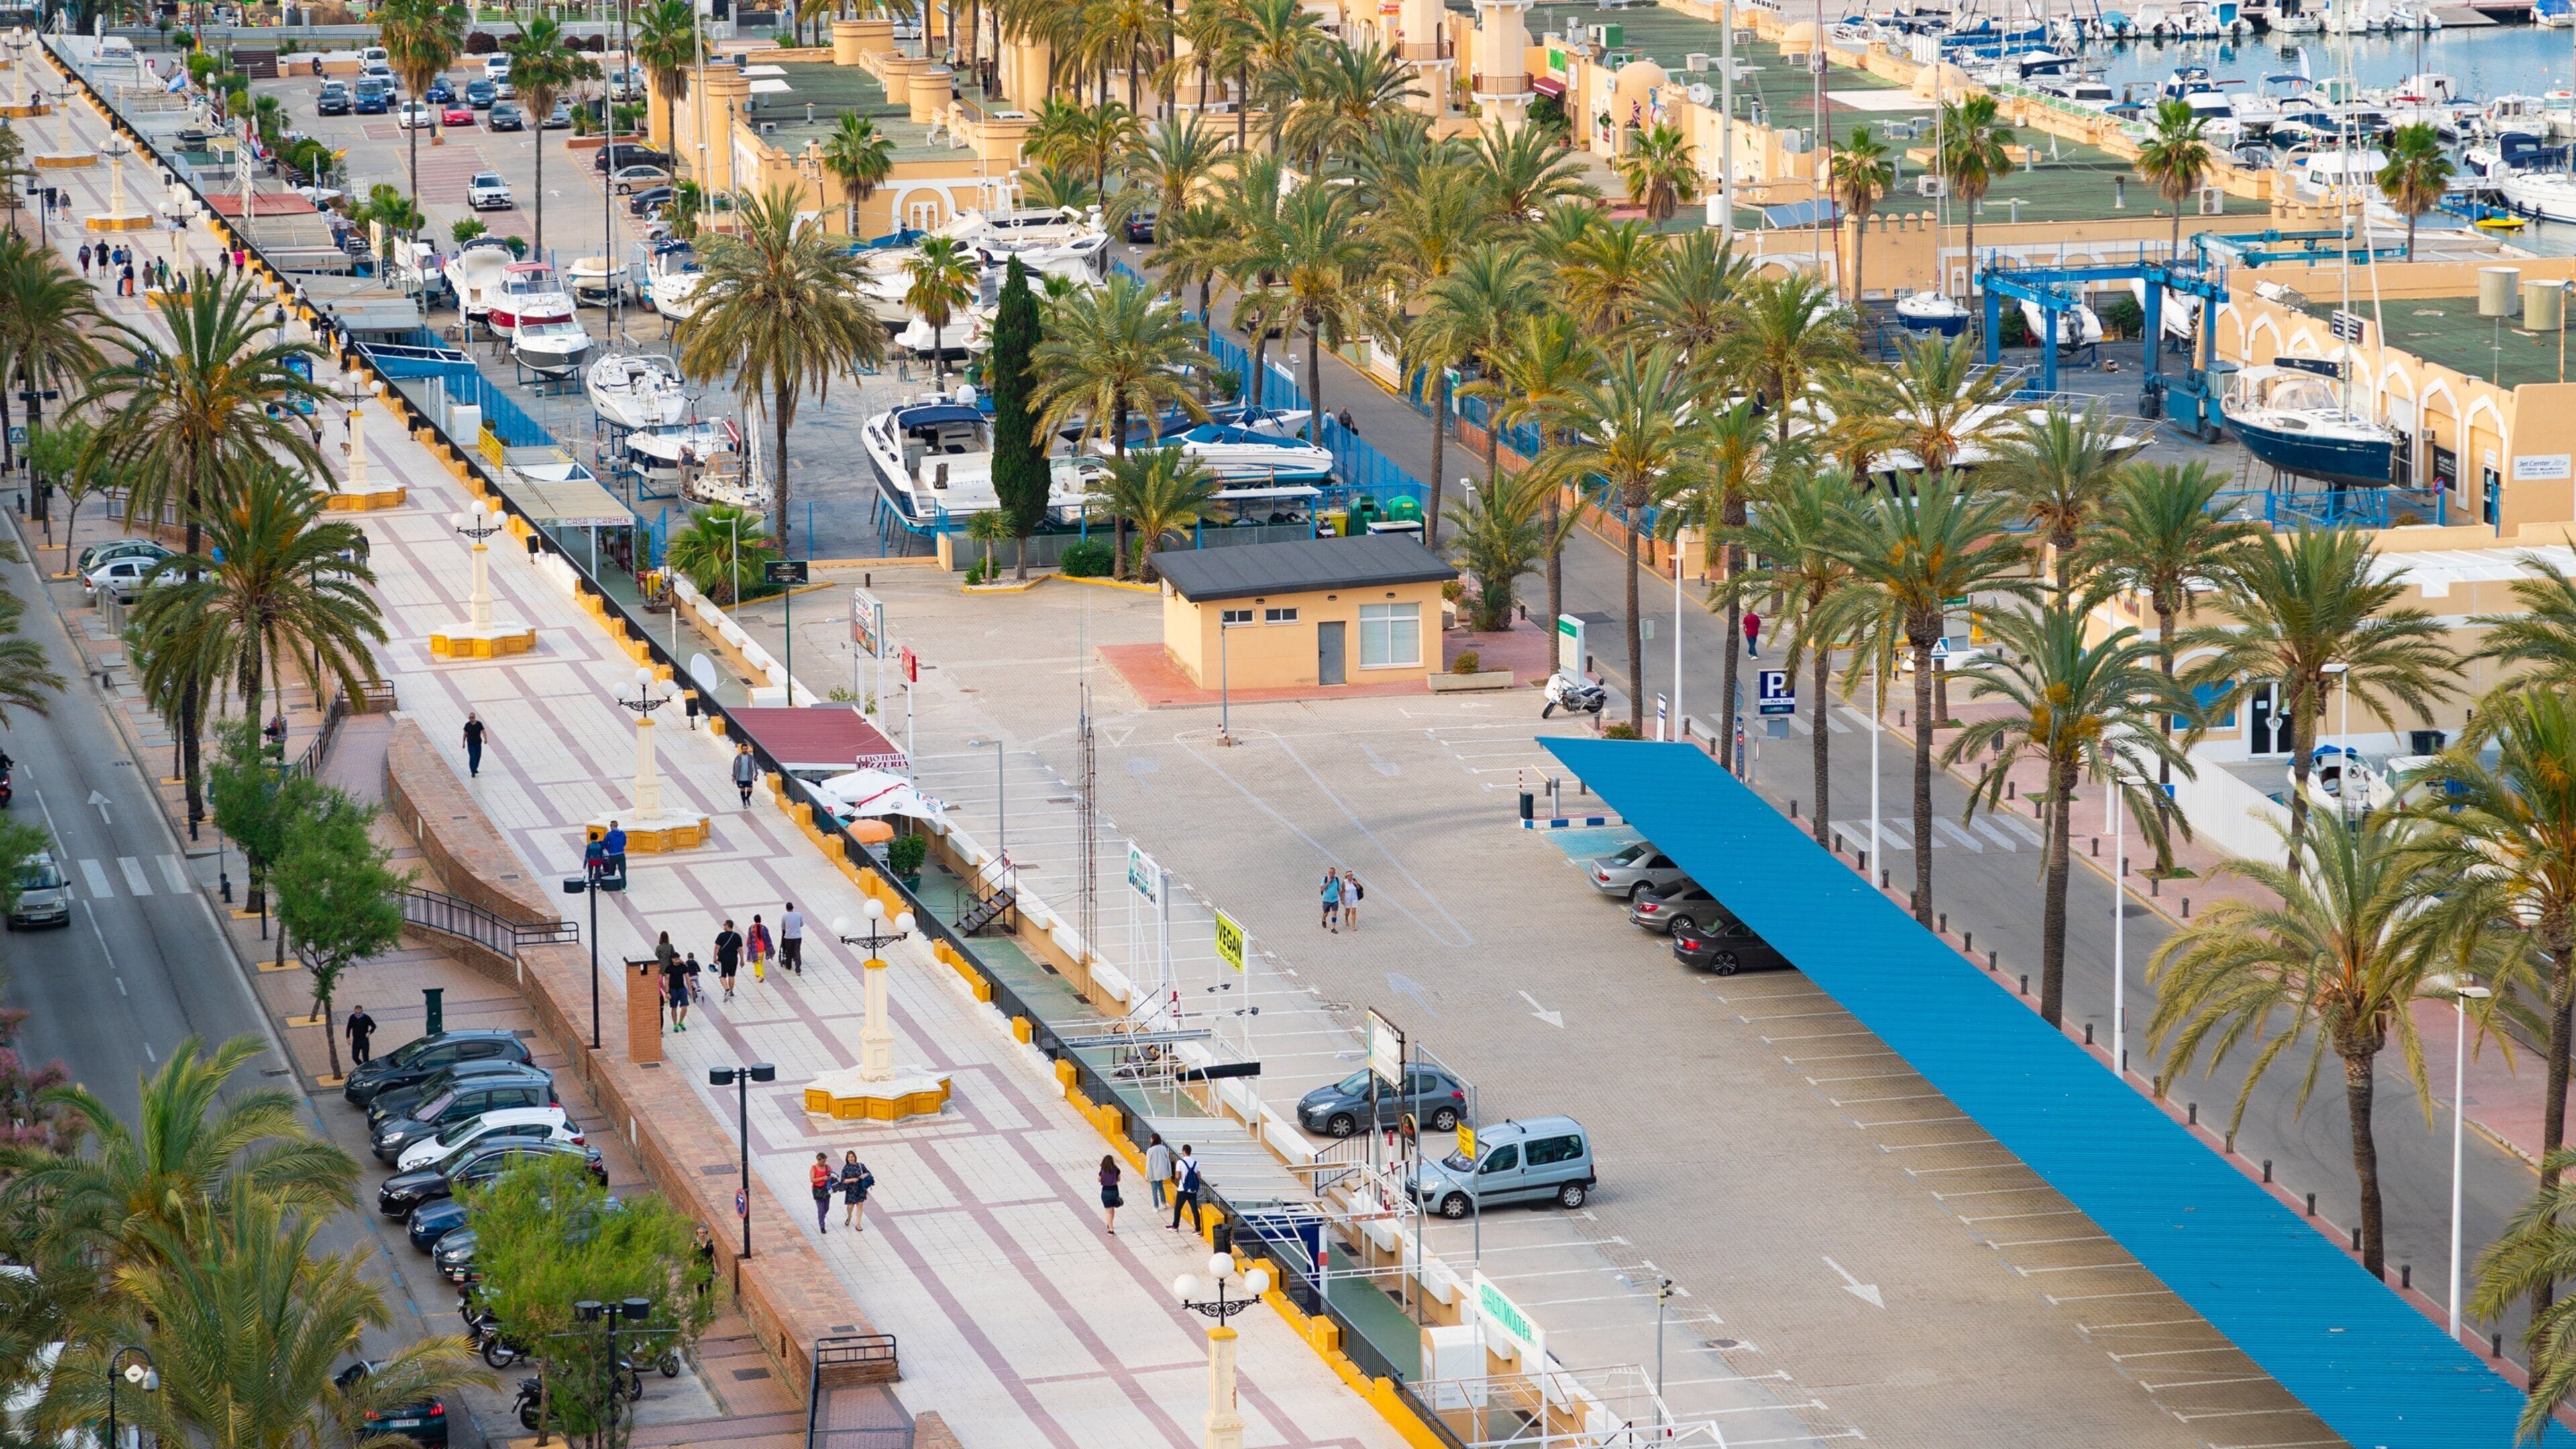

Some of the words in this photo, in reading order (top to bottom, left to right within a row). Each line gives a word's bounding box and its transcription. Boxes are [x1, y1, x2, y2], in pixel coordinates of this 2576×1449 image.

[1767, 672, 1786, 698] P
[857, 761, 909, 769] PIZZERIA
[859, 755, 880, 763] CIAO
[881, 753, 906, 761] ITALIA
[1218, 920, 1242, 961] VEGAN
[1480, 1284, 1501, 1318] SALT
[1503, 1303, 1533, 1346] WATER
